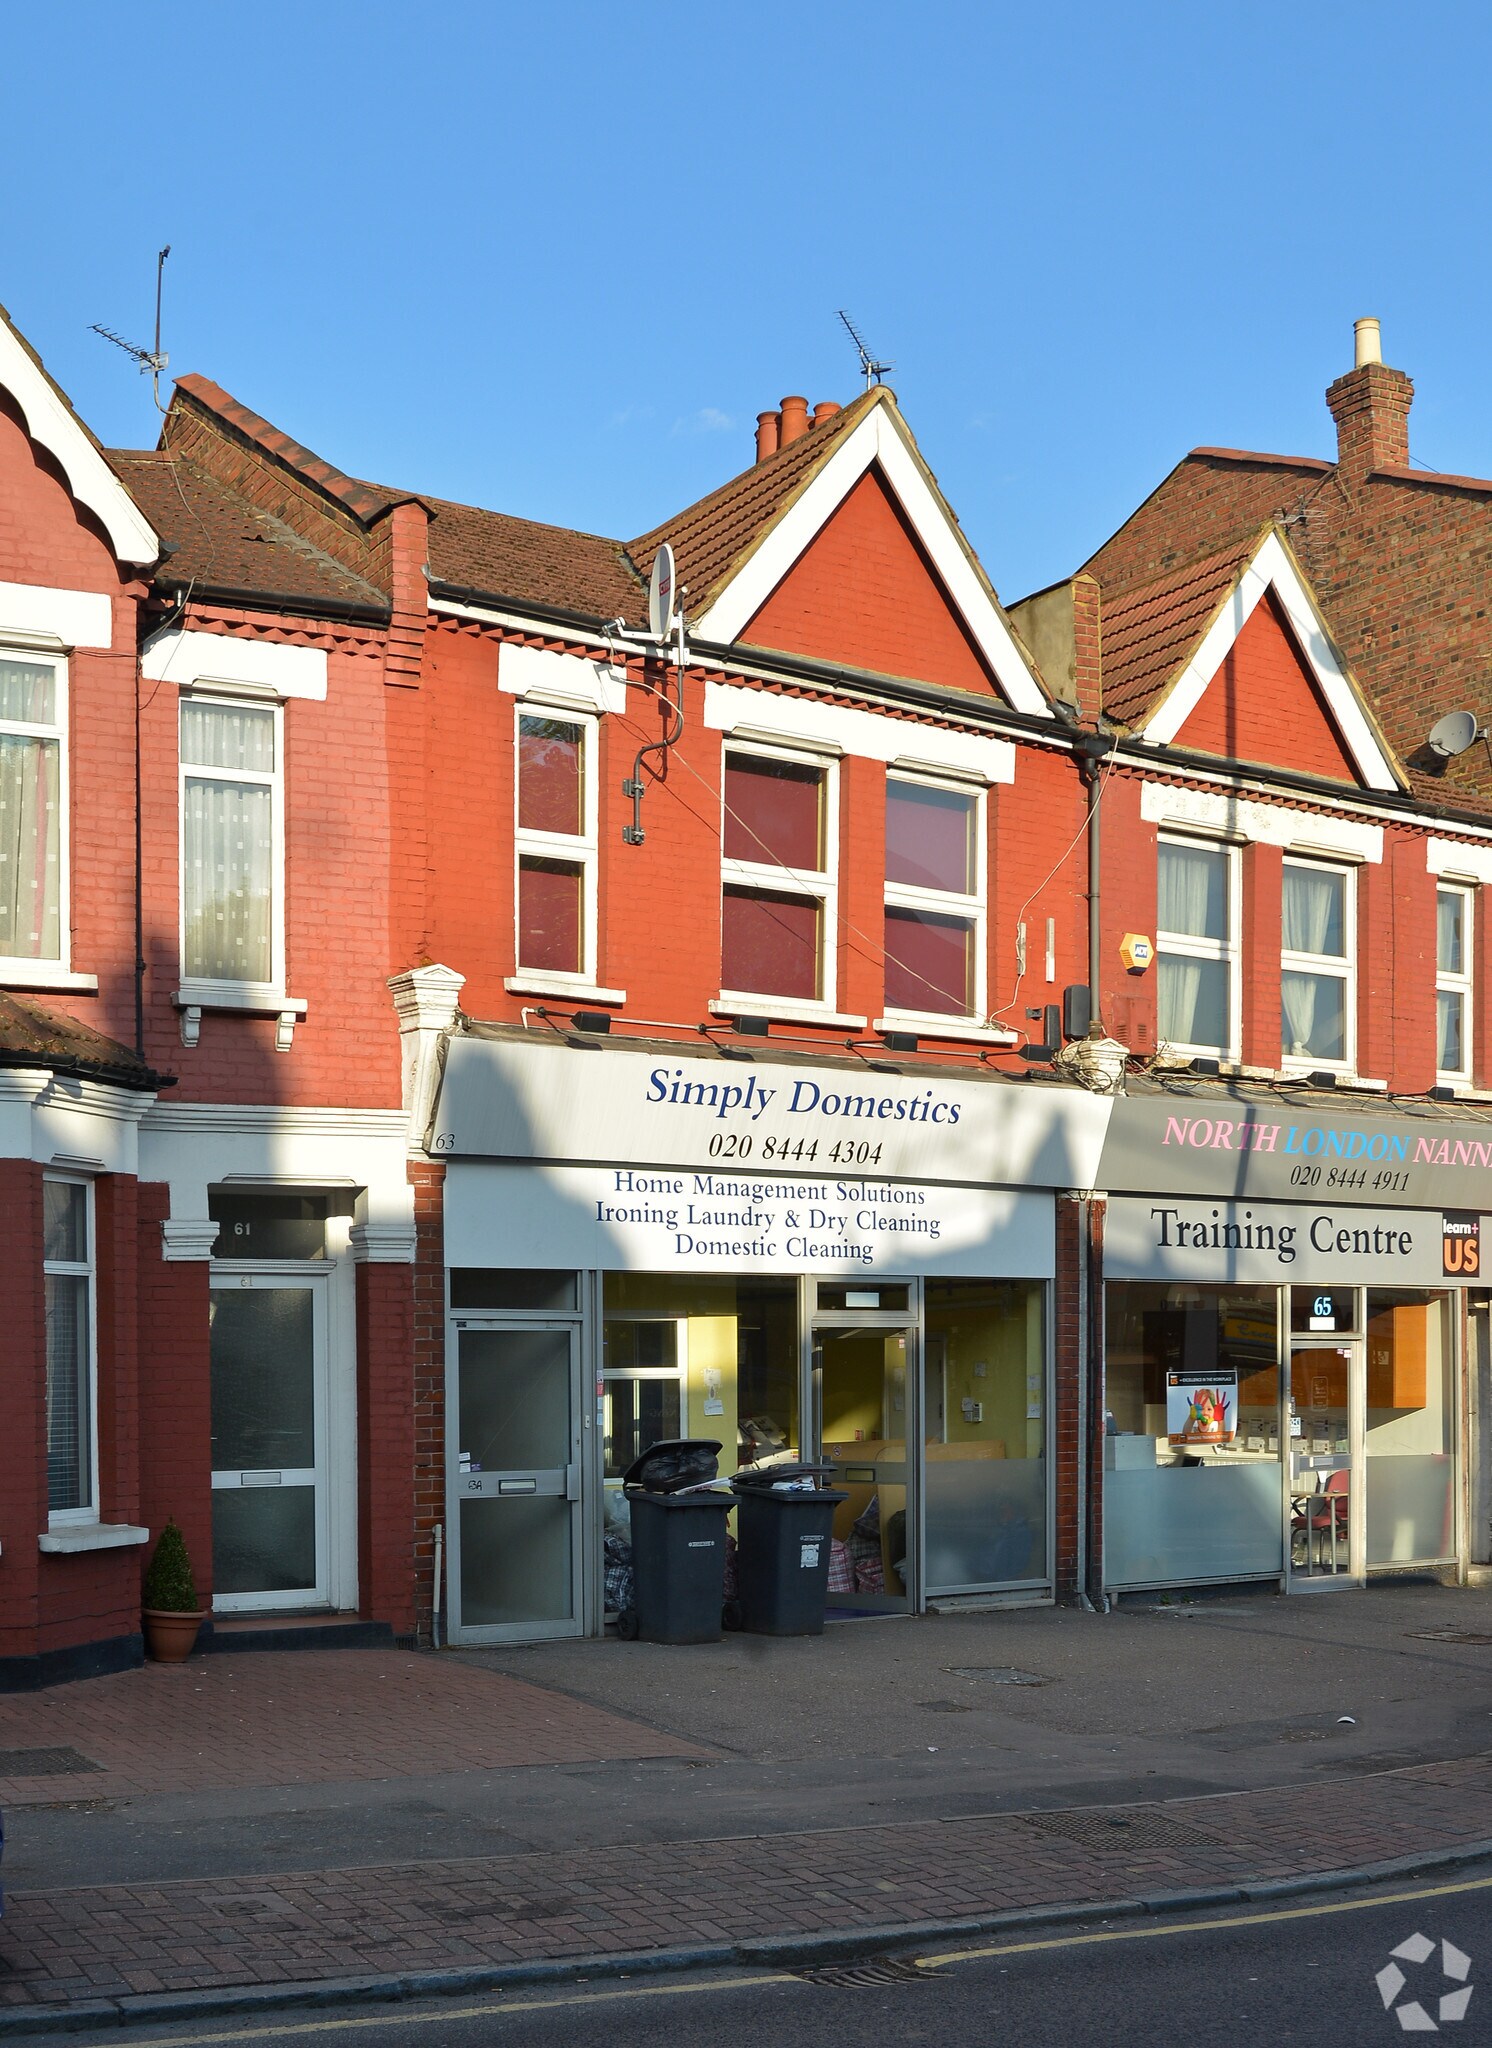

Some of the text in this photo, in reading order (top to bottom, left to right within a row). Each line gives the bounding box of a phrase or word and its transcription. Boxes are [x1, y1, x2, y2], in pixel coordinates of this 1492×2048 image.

[646, 1069, 962, 1126] Simply Domestics
[435, 1133, 456, 1151] 63
[709, 1134, 883, 1166] 020 8444 4304
[1162, 1117, 1492, 1168] NORTH LONDON NANN
[614, 1171, 926, 1206] Home Management Solutions
[1290, 1165, 1410, 1192] 020 8444 4911
[234, 1222, 251, 1236] 61
[595, 1200, 941, 1240] Ironing Laundry & Dry Cleaning
[1150, 1207, 1413, 1264] Training Centre
[674, 1232, 874, 1266] Domestic Cleaning
[1443, 1238, 1479, 1272] US
[1313, 1297, 1332, 1317] 65
